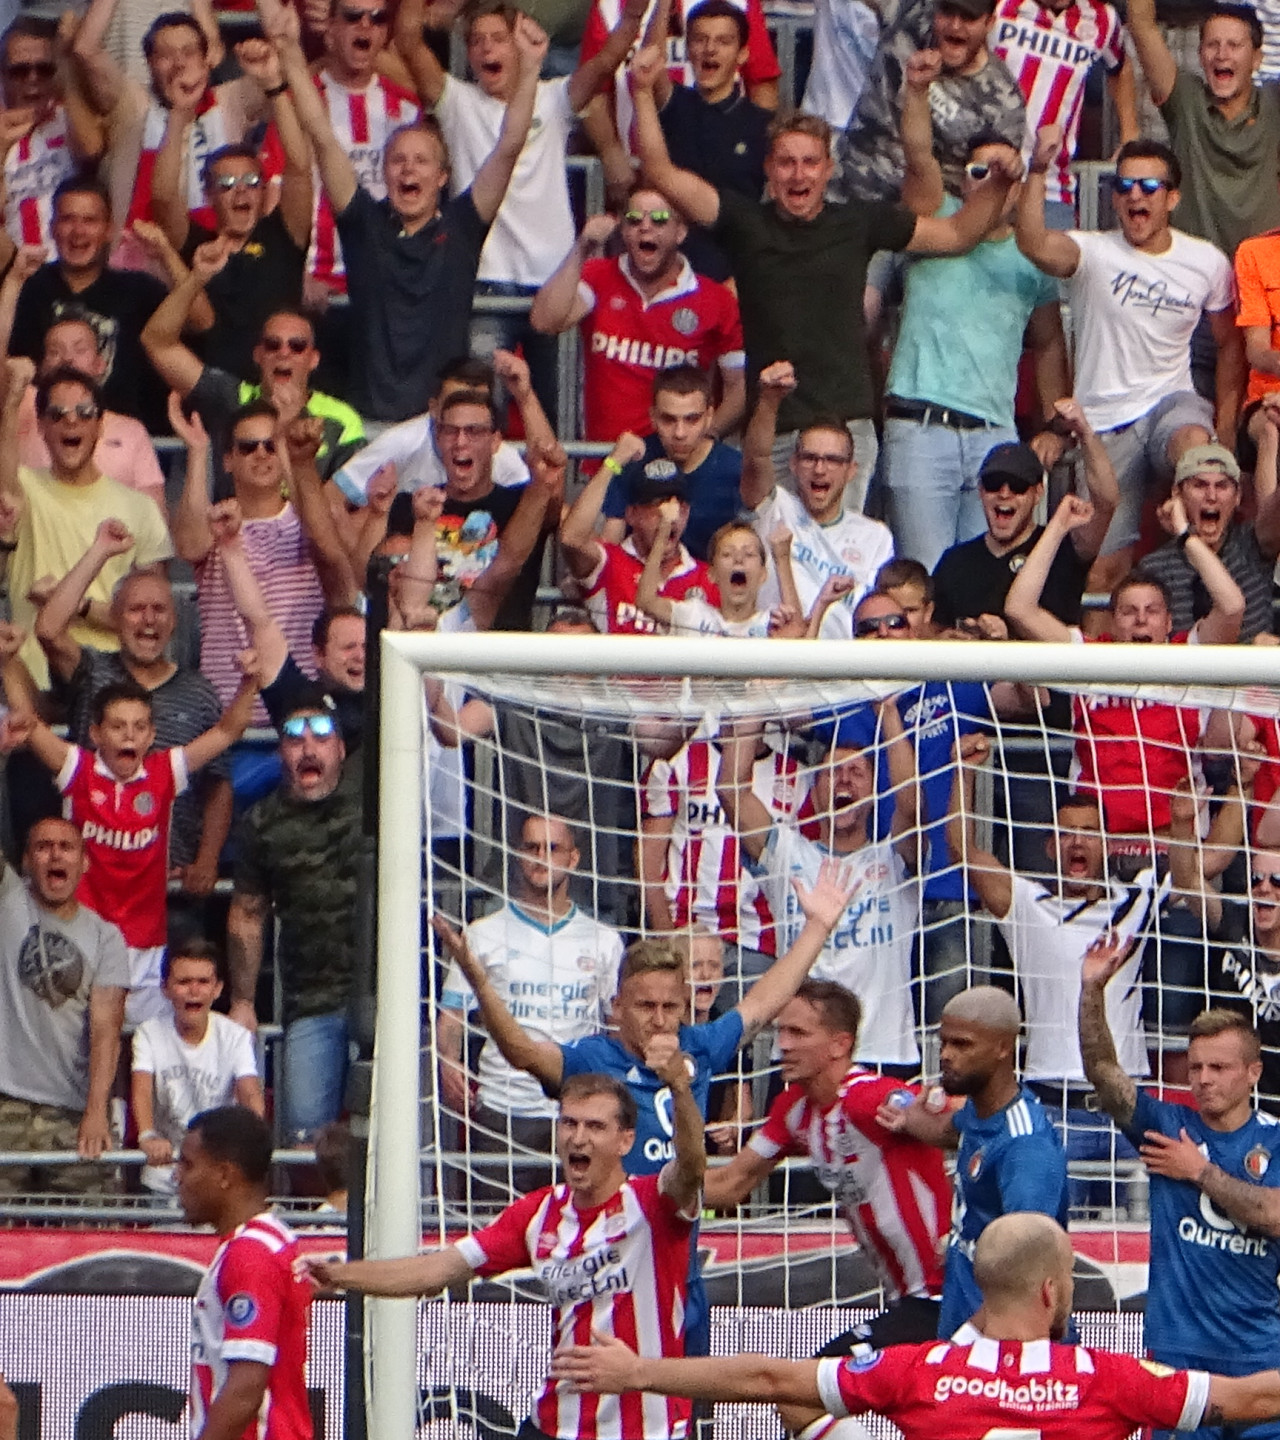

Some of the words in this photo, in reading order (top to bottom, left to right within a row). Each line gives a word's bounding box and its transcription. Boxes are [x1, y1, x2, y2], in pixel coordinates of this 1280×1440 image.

[999, 23, 1099, 65] PHILIPS
[592, 332, 699, 368] PHILIPS
[509, 981, 591, 1004] energie
[1178, 1215, 1267, 1258] Qurrent
[934, 1376, 1080, 1402] goodhabitz
[999, 1401, 1034, 1411] online
[1036, 1401, 1080, 1411] training
